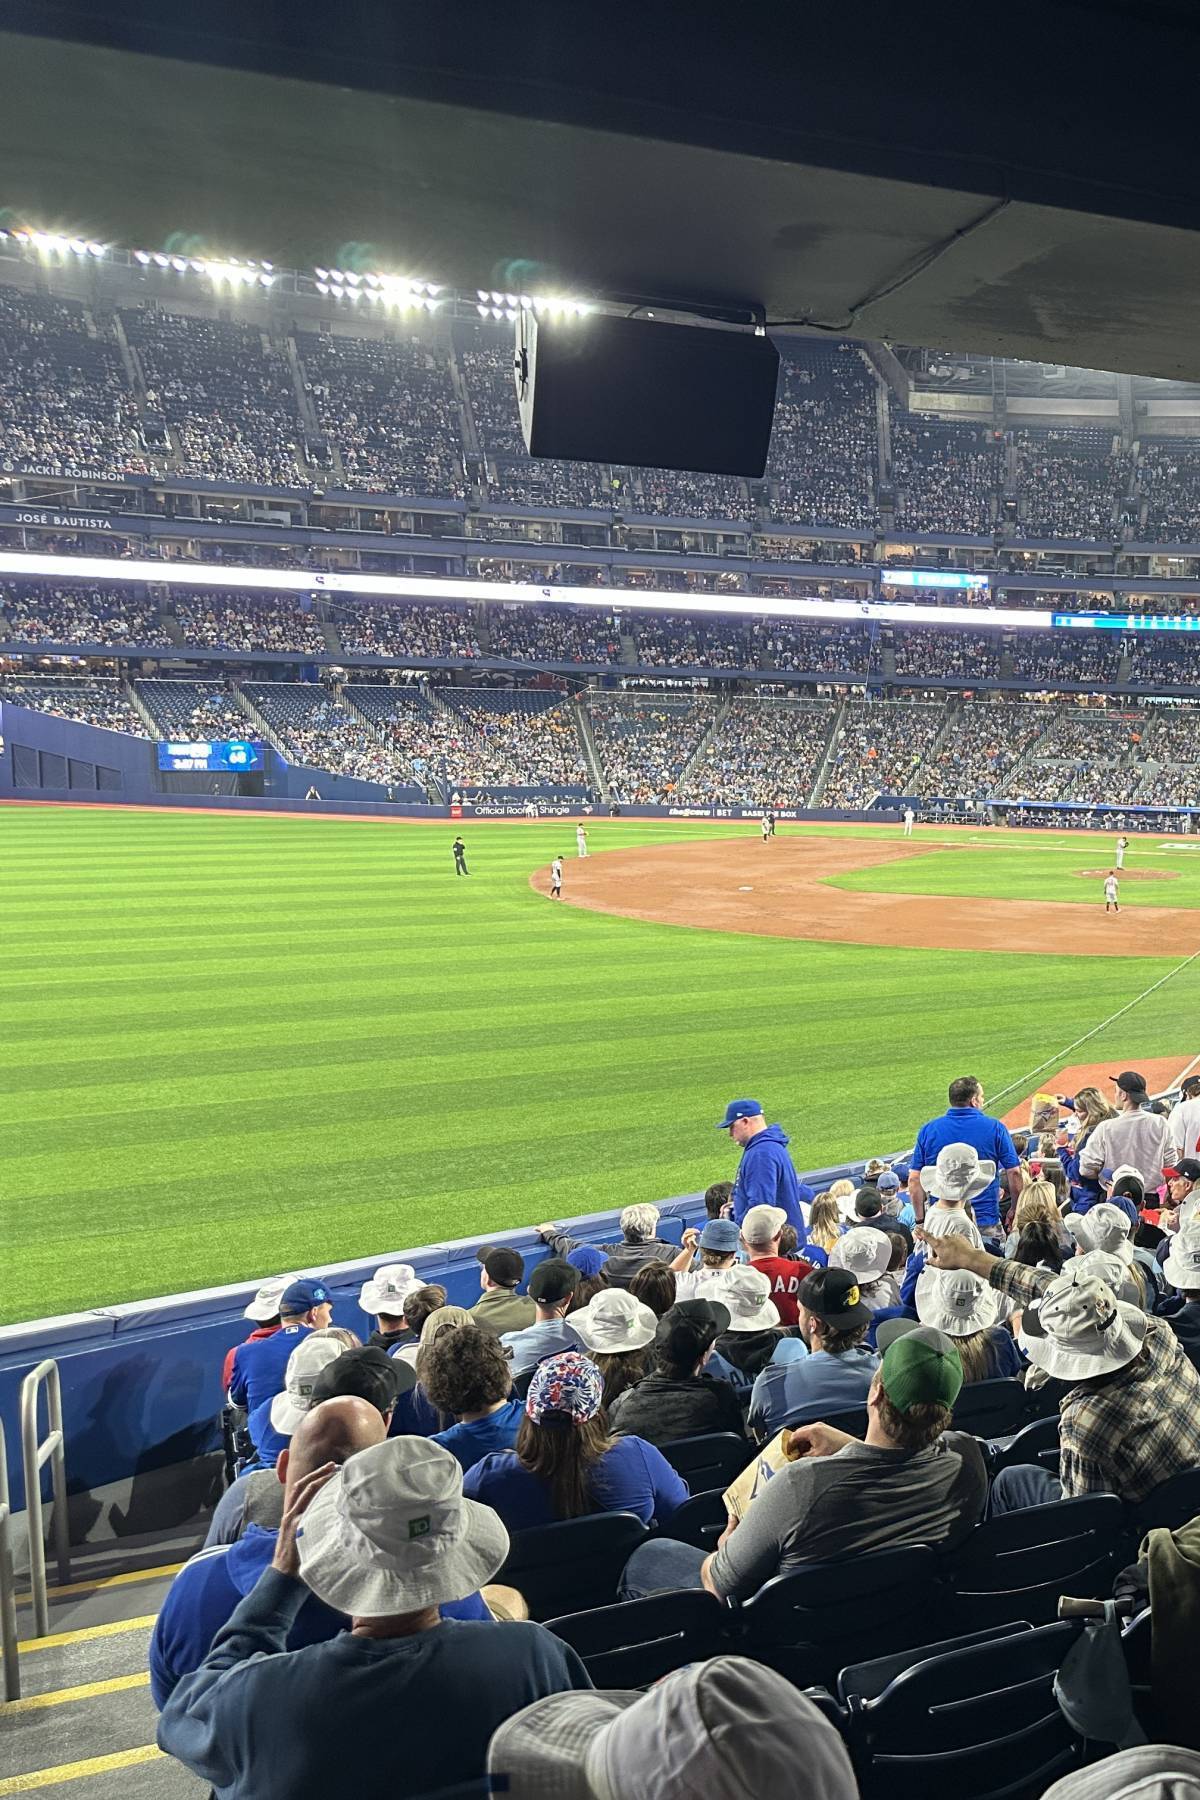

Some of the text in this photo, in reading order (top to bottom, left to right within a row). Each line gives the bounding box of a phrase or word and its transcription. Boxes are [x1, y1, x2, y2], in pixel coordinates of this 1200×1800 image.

[21, 464, 125, 482] JACKIE ROBINSON
[16, 513, 112, 529] JOSÉ BAUTISTA
[475, 806, 505, 815] Official
[539, 806, 569, 816] Shingle
[716, 809, 733, 817] BET
[773, 1275, 799, 1293] AD
